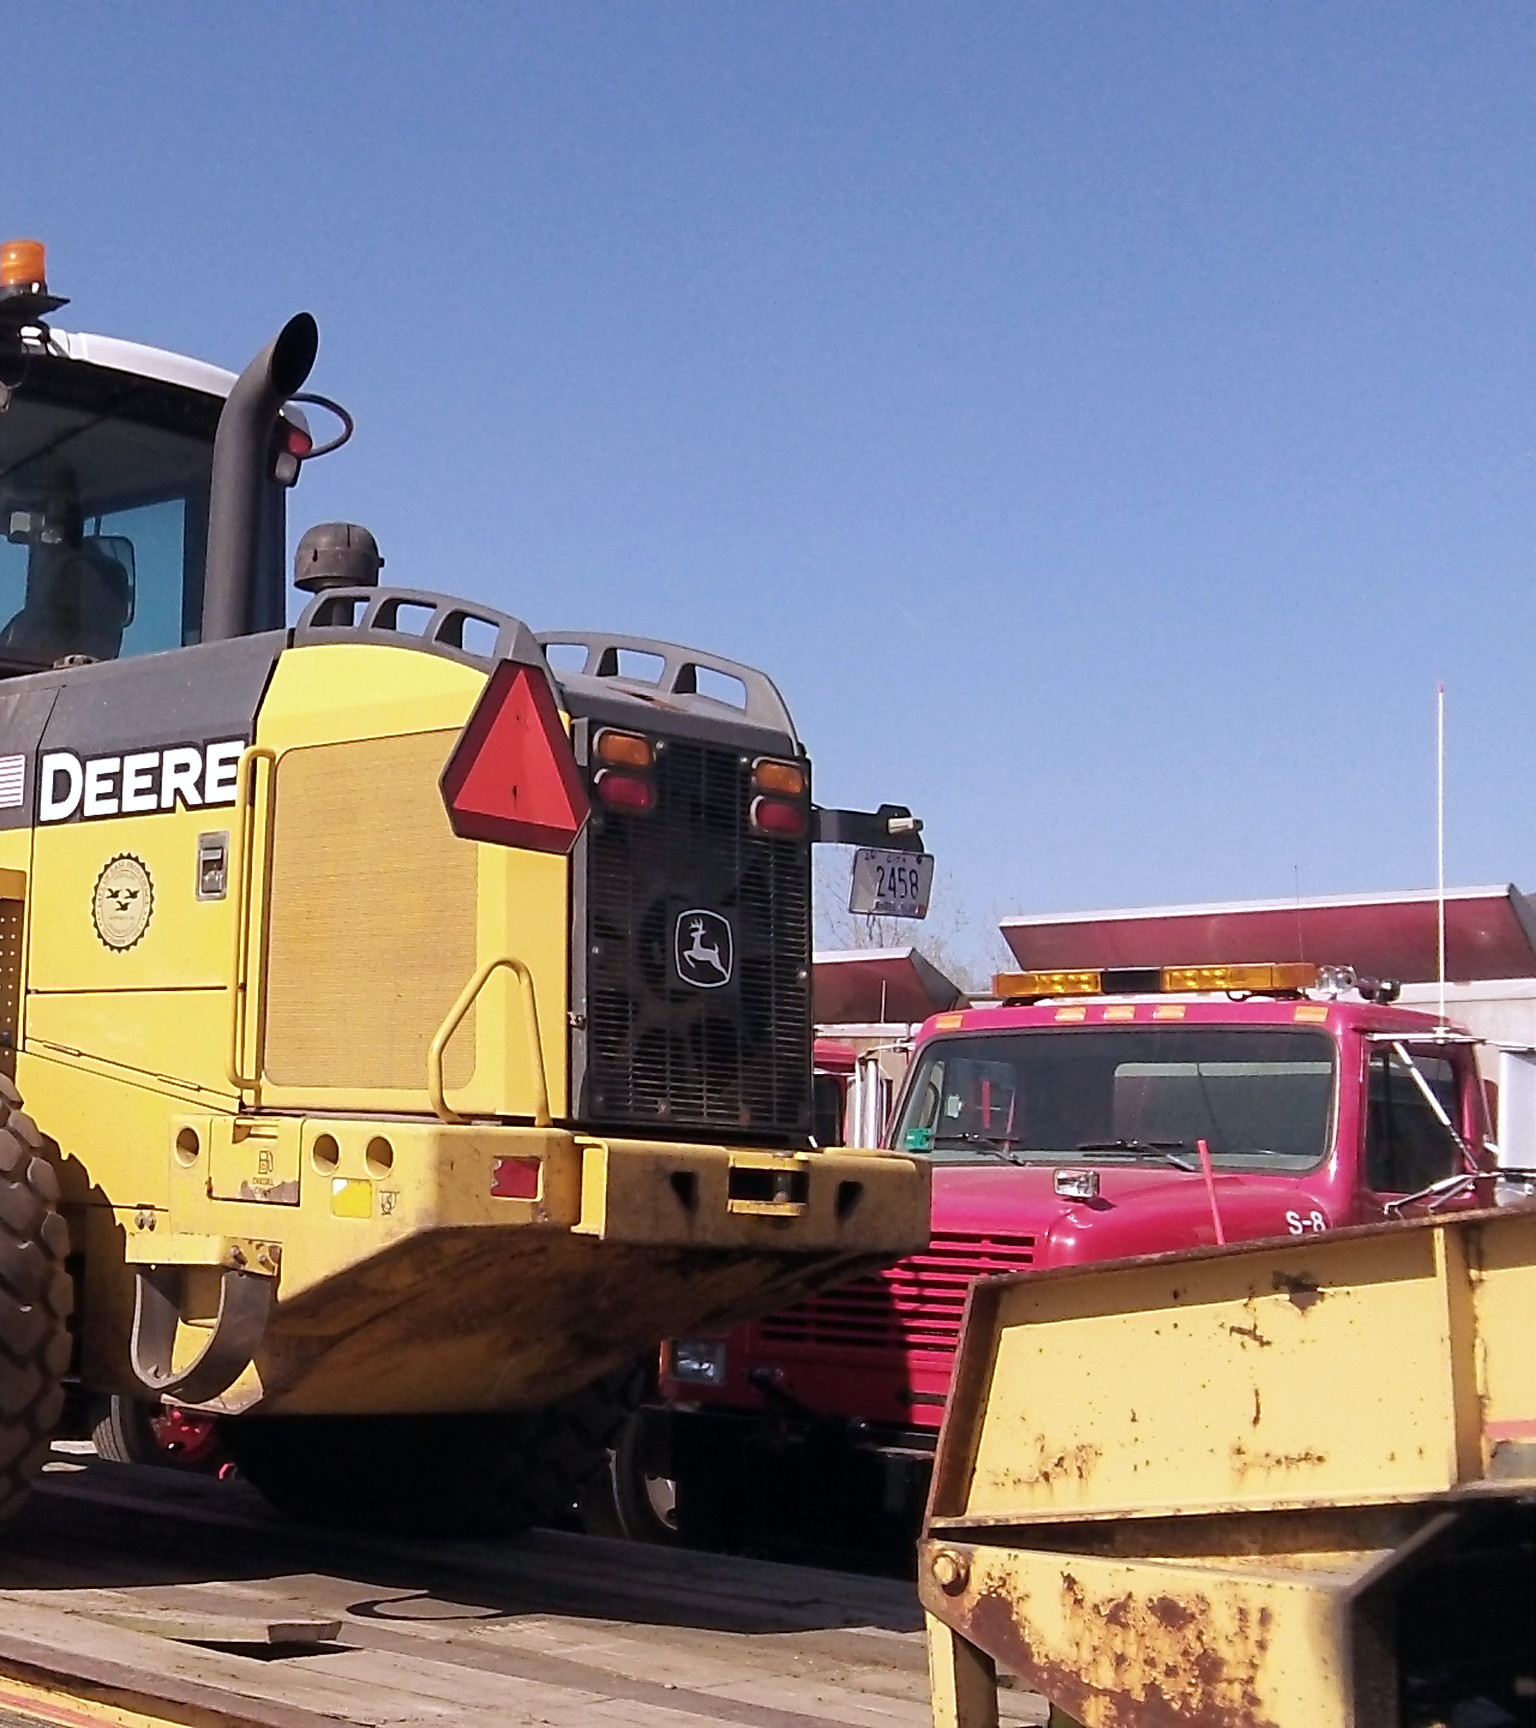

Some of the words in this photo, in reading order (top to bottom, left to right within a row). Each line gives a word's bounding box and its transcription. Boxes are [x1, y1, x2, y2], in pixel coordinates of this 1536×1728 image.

[38, 740, 246, 822] DEERE
[876, 864, 920, 900] 2458
[1285, 1210, 1326, 1235] S-8
